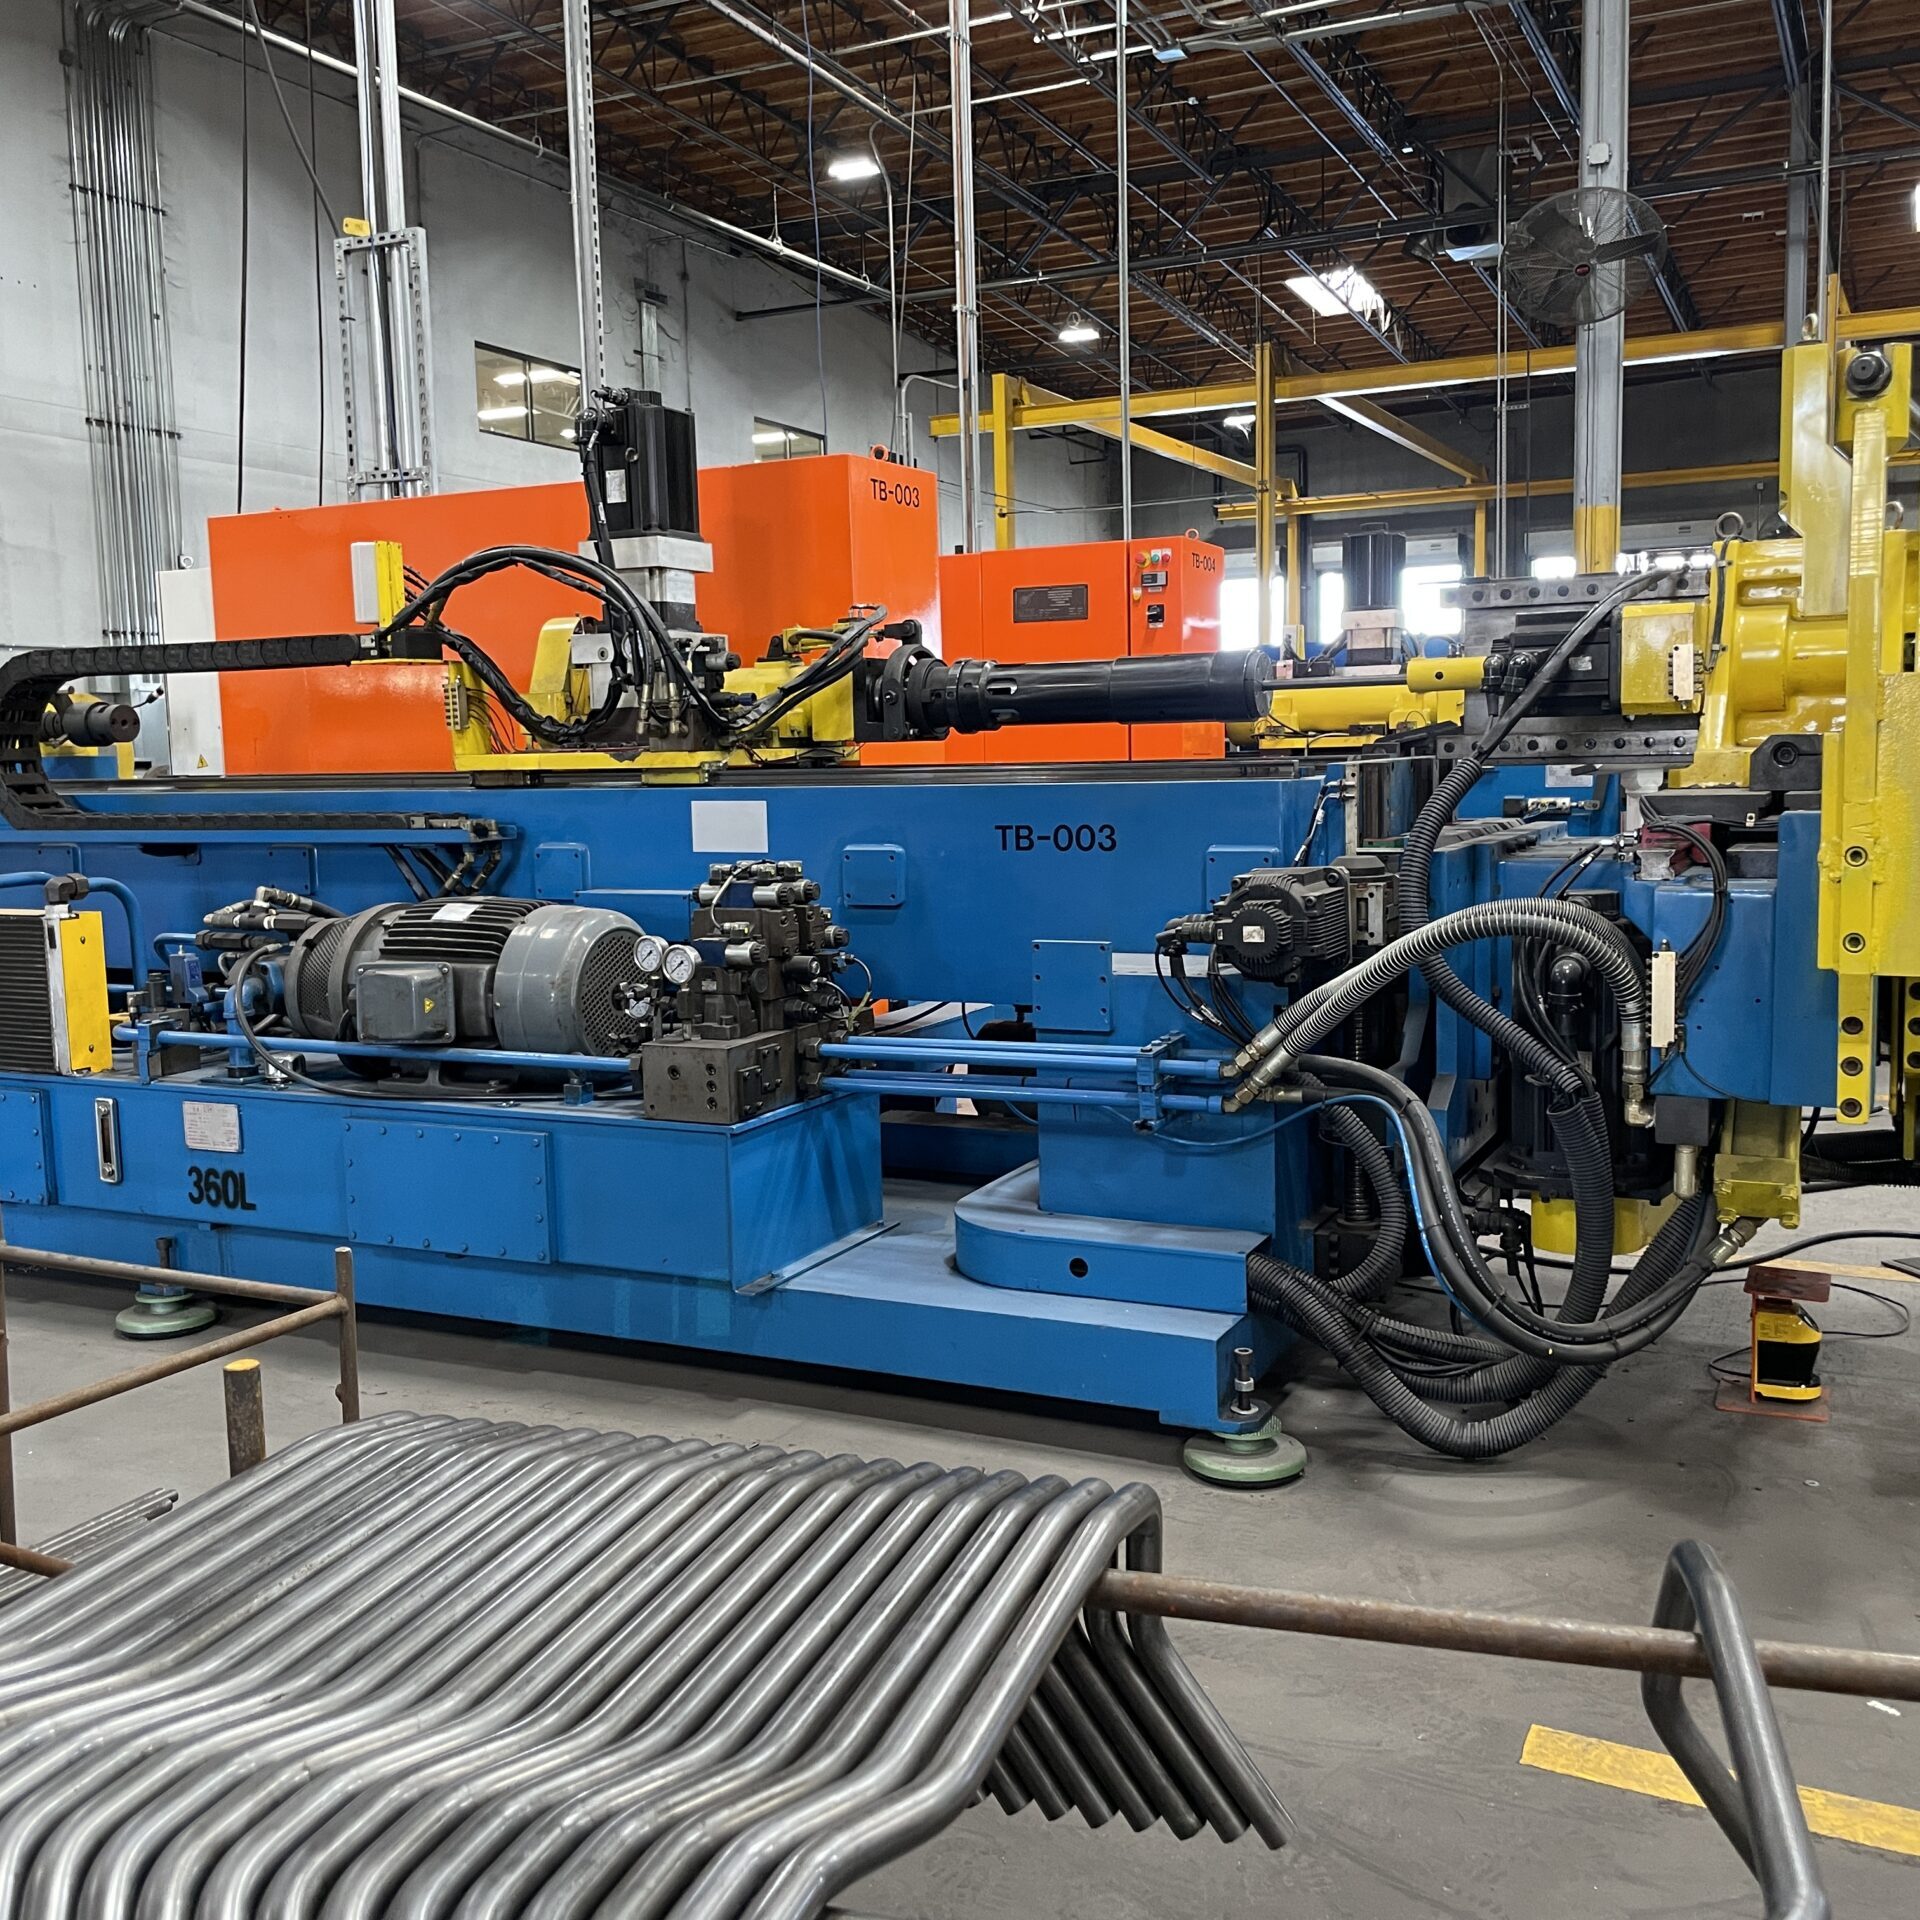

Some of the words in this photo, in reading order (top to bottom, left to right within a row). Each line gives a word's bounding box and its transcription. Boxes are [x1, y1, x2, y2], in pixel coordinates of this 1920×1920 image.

[870, 478, 919, 508] TB-003
[1192, 552, 1216, 573] TB-004
[994, 824, 1117, 852] TB-003
[188, 1166, 257, 1211] 360L
